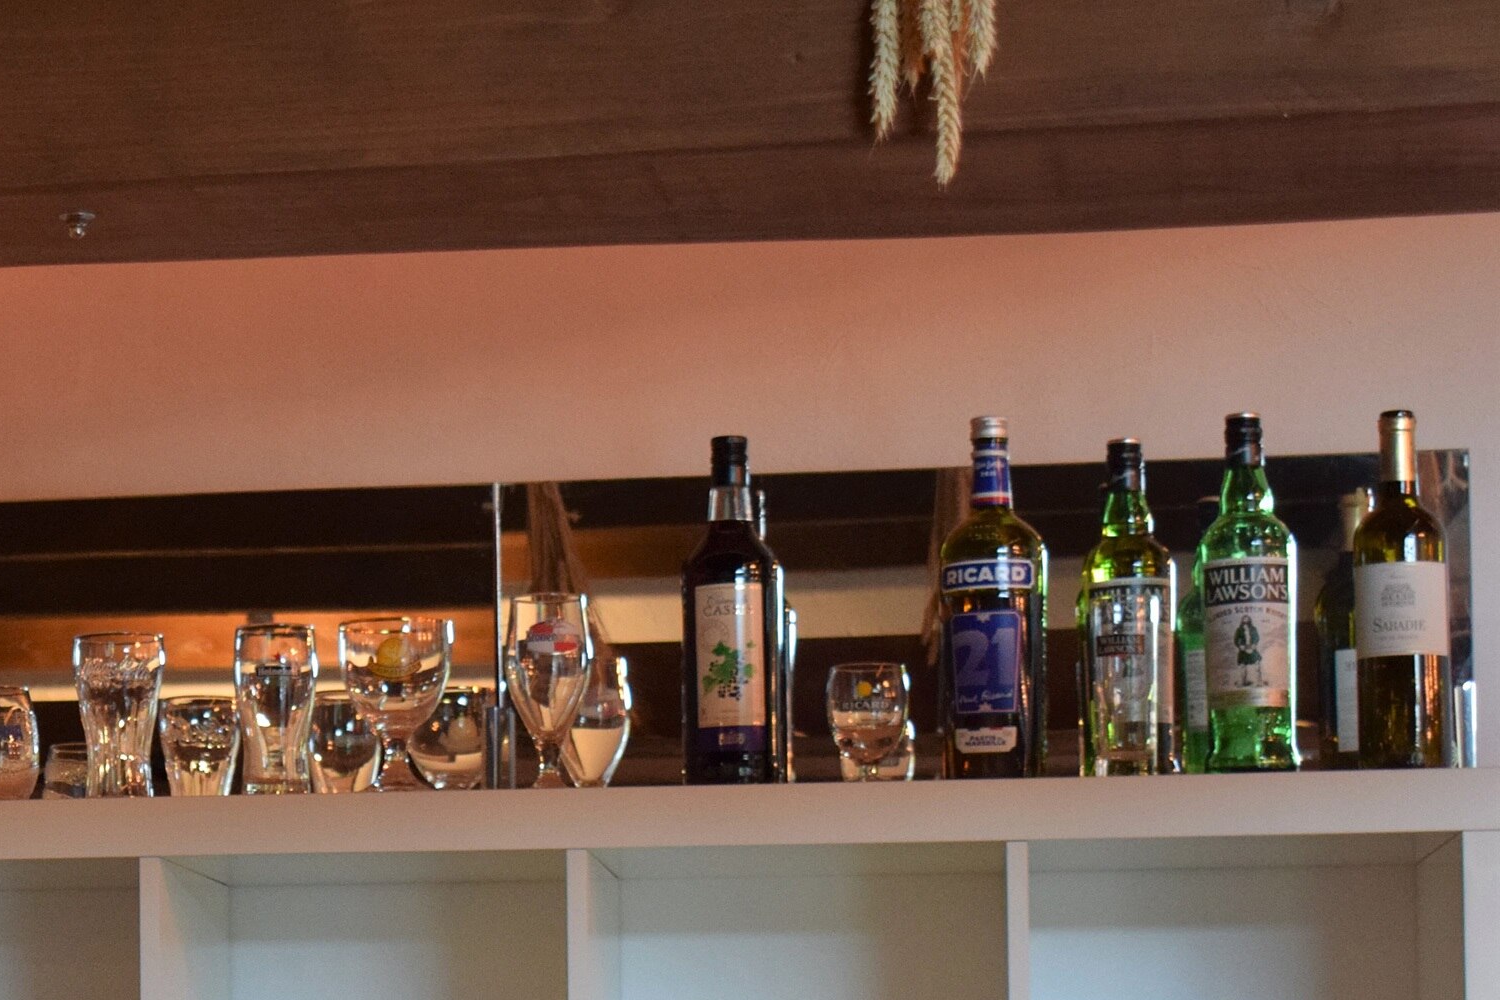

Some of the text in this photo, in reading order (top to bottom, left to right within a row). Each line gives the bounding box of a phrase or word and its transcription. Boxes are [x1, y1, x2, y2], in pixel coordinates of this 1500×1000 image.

[946, 566, 1026, 585] RICARD
[1208, 566, 1285, 586] WILLIAM
[952, 627, 1018, 688] 21
[842, 700, 890, 711] RICARD
